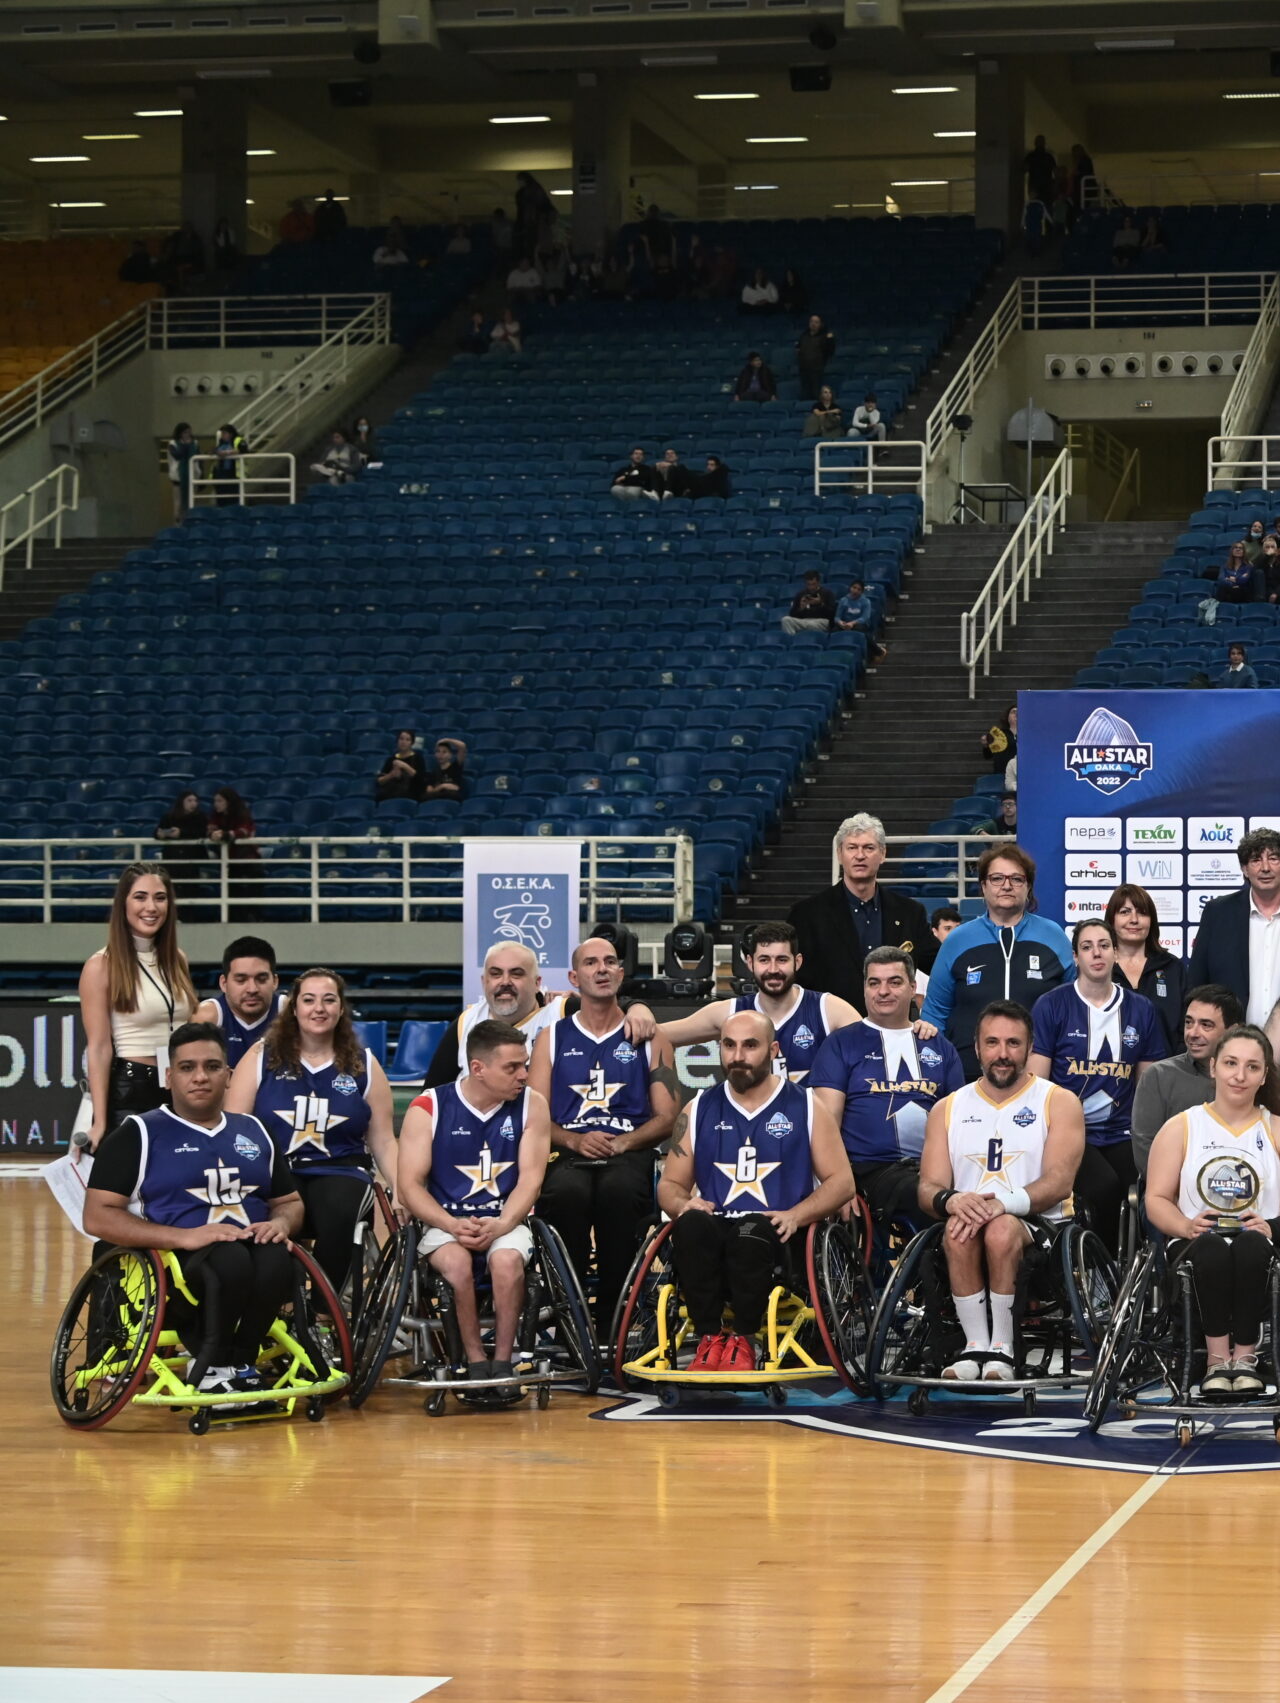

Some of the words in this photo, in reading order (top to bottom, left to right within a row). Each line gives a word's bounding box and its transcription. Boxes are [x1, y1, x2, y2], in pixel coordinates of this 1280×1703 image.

[1070, 747, 1103, 765] ALL
[1104, 747, 1148, 765] STAR
[1094, 763, 1122, 772] OAKA
[1096, 776, 1121, 785] 2022
[1070, 827, 1106, 840] nepa
[1070, 869, 1117, 878] athlos
[1066, 1060, 1097, 1076] ALL
[1099, 1062, 1133, 1079] STAR
[587, 1068, 605, 1101] 3
[870, 1080, 897, 1094] ALL
[899, 1080, 938, 1097] STAR
[293, 1094, 329, 1133] 14
[986, 1137, 1004, 1172] 6
[479, 1148, 492, 1182] 1
[735, 1145, 758, 1184] 6
[203, 1166, 243, 1207] 15
[1210, 1179, 1226, 1188] ALL
[1226, 1179, 1246, 1189] STAR
